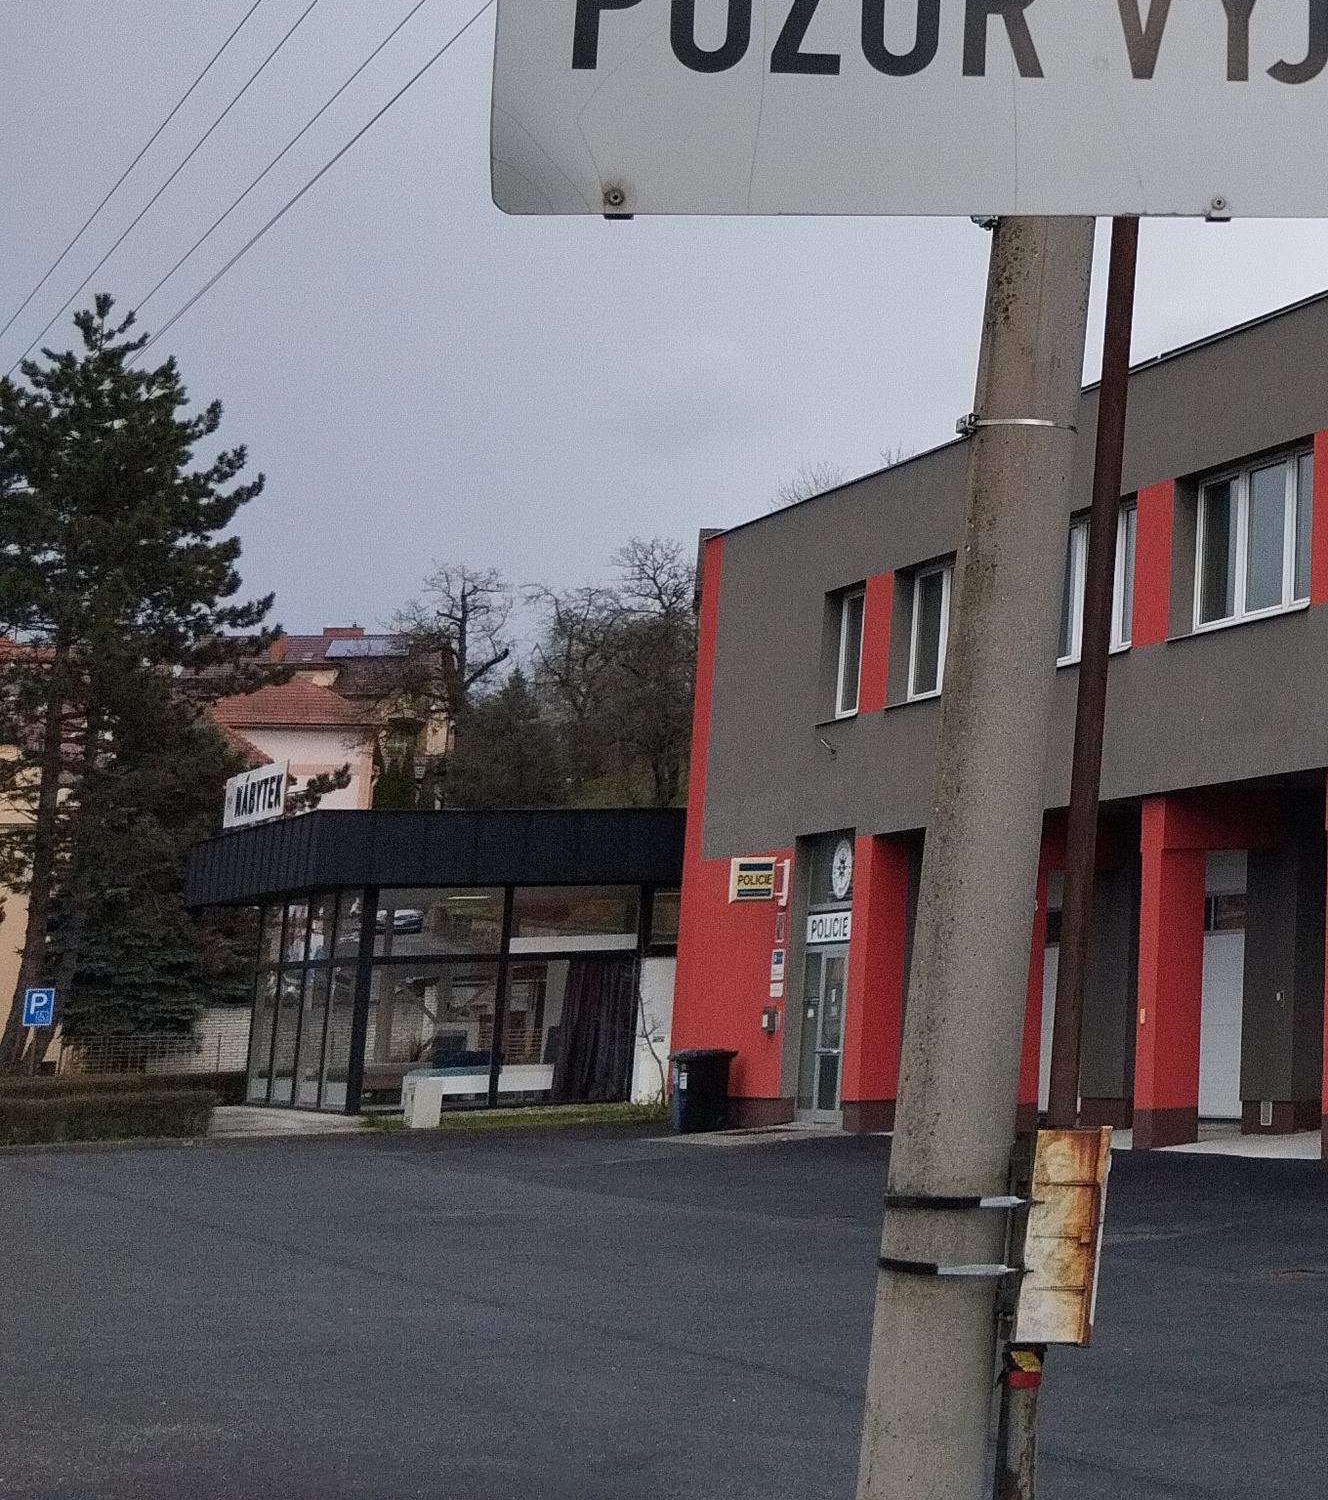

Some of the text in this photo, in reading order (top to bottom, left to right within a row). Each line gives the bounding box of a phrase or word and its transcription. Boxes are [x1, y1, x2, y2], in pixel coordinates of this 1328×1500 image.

[234, 774, 284, 818] NÁBYTEK
[737, 874, 773, 886] POLICIE
[811, 917, 849, 939] POLICIE
[30, 993, 48, 1014] P
